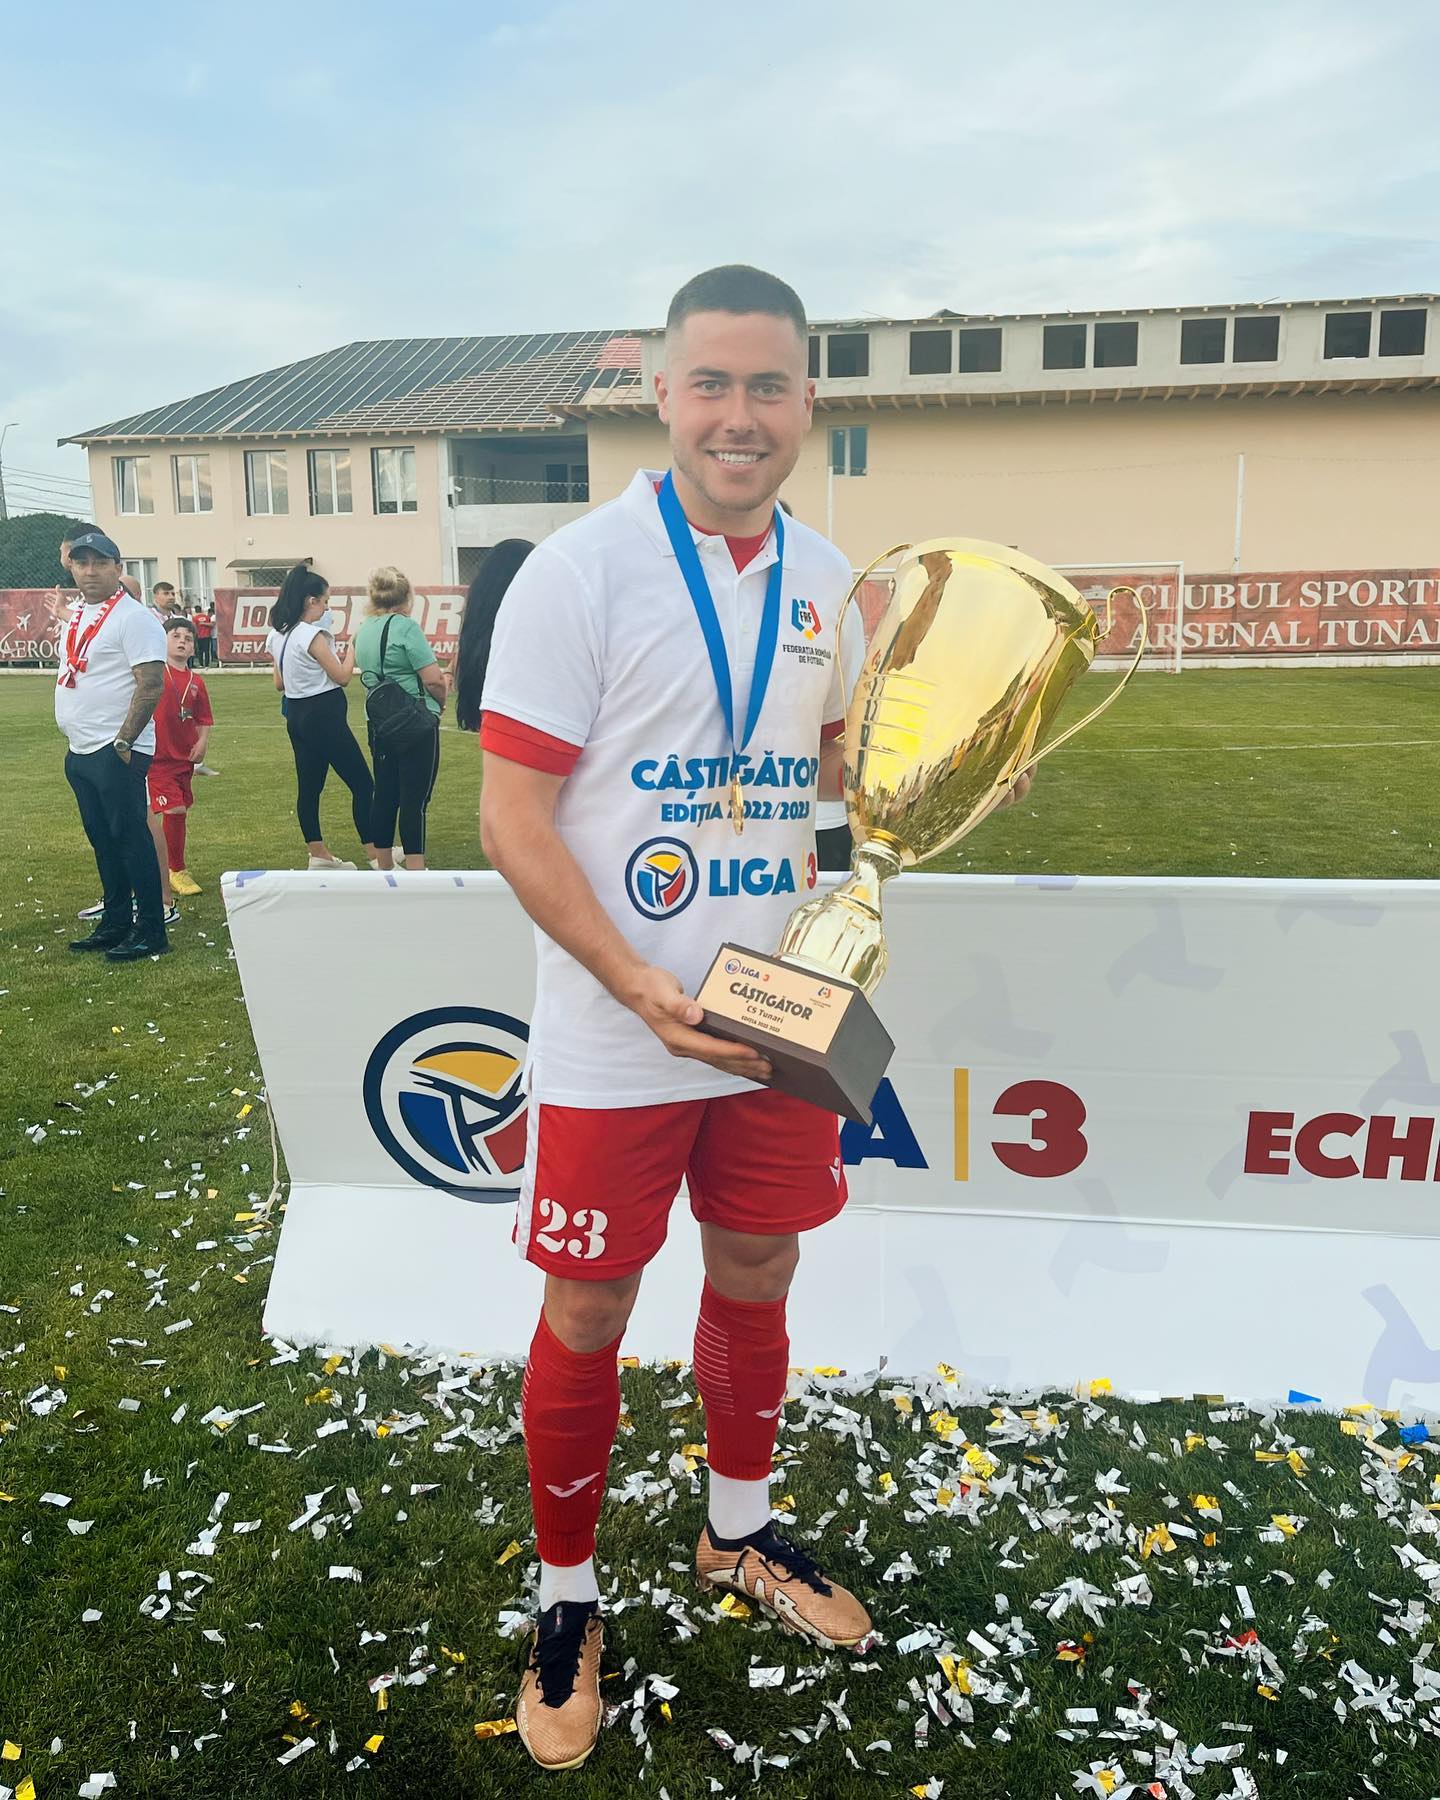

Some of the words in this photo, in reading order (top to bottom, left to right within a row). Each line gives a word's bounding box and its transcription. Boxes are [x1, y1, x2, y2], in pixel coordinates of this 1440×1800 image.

[1126, 621, 1310, 649] ARSENAL
[1320, 618, 1440, 646] TUNA
[709, 858, 796, 896] LIGA
[807, 852, 817, 889] 3
[740, 966, 760, 979] LIGA
[746, 1005, 758, 1014] CS
[759, 1008, 784, 1023] Tunari
[991, 1080, 1088, 1178] 3
[1244, 1111, 1440, 1182] ECH
[536, 1198, 608, 1259] 23
